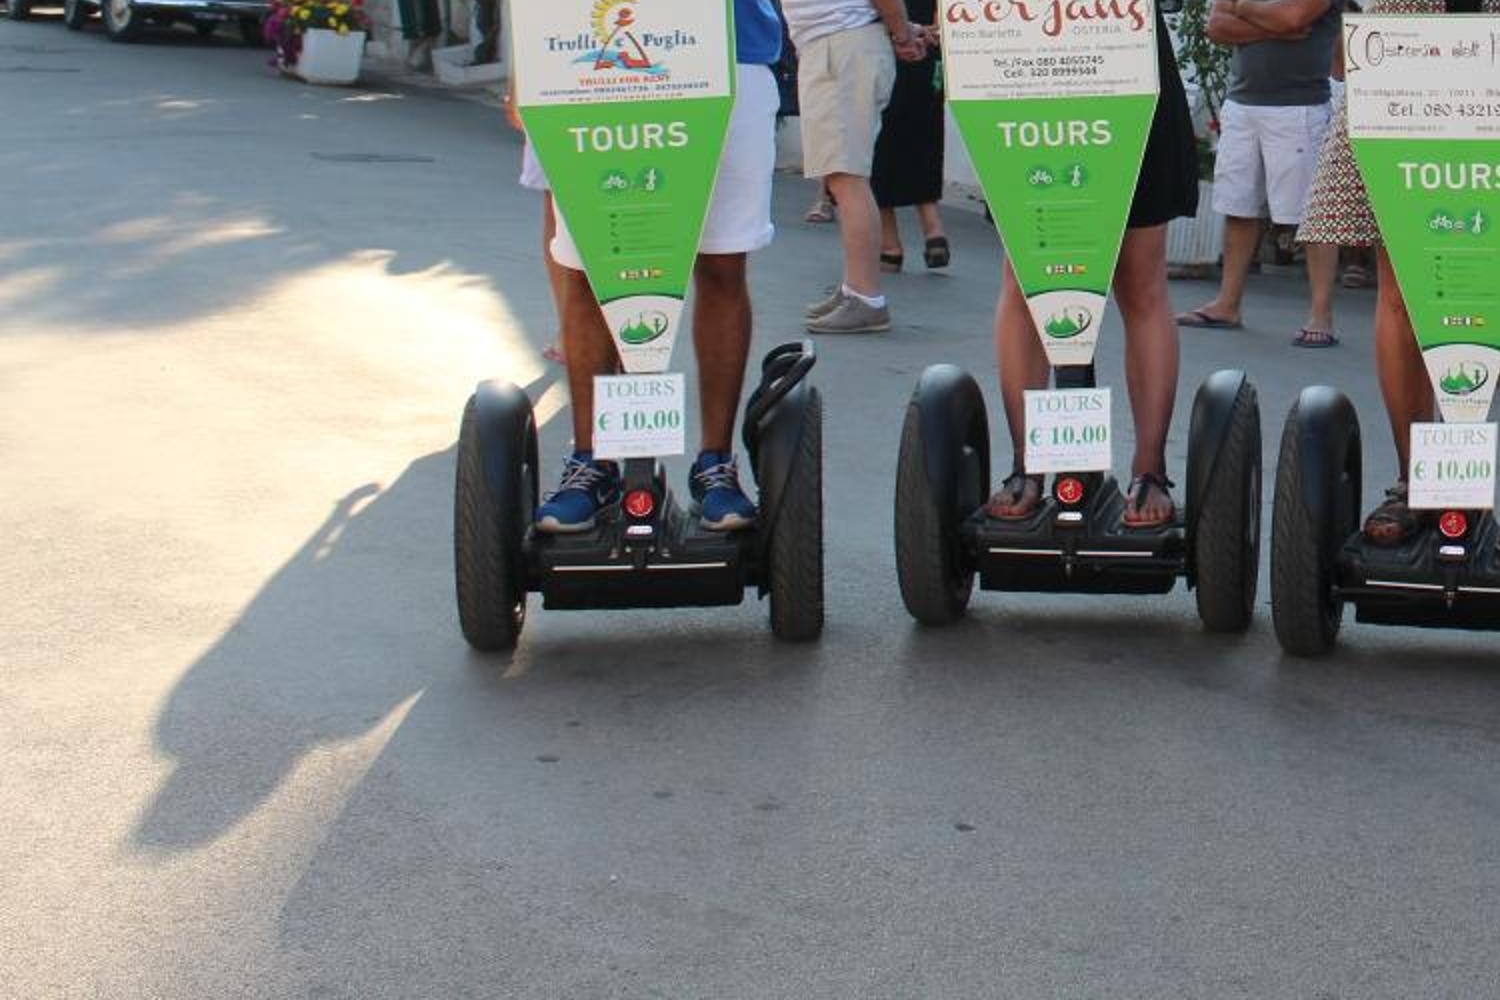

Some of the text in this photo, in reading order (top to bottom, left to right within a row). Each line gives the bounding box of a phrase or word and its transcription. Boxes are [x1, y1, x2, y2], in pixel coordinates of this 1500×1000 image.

[545, 31, 597, 52] Trulli
[642, 29, 697, 49] Puglia
[1423, 103, 1451, 117] 080
[568, 121, 689, 152] TOURS
[998, 119, 1112, 148] TOURS
[604, 380, 675, 399] TOURS
[1035, 394, 1103, 414] TOURS
[1420, 429, 1488, 446] TOURS
